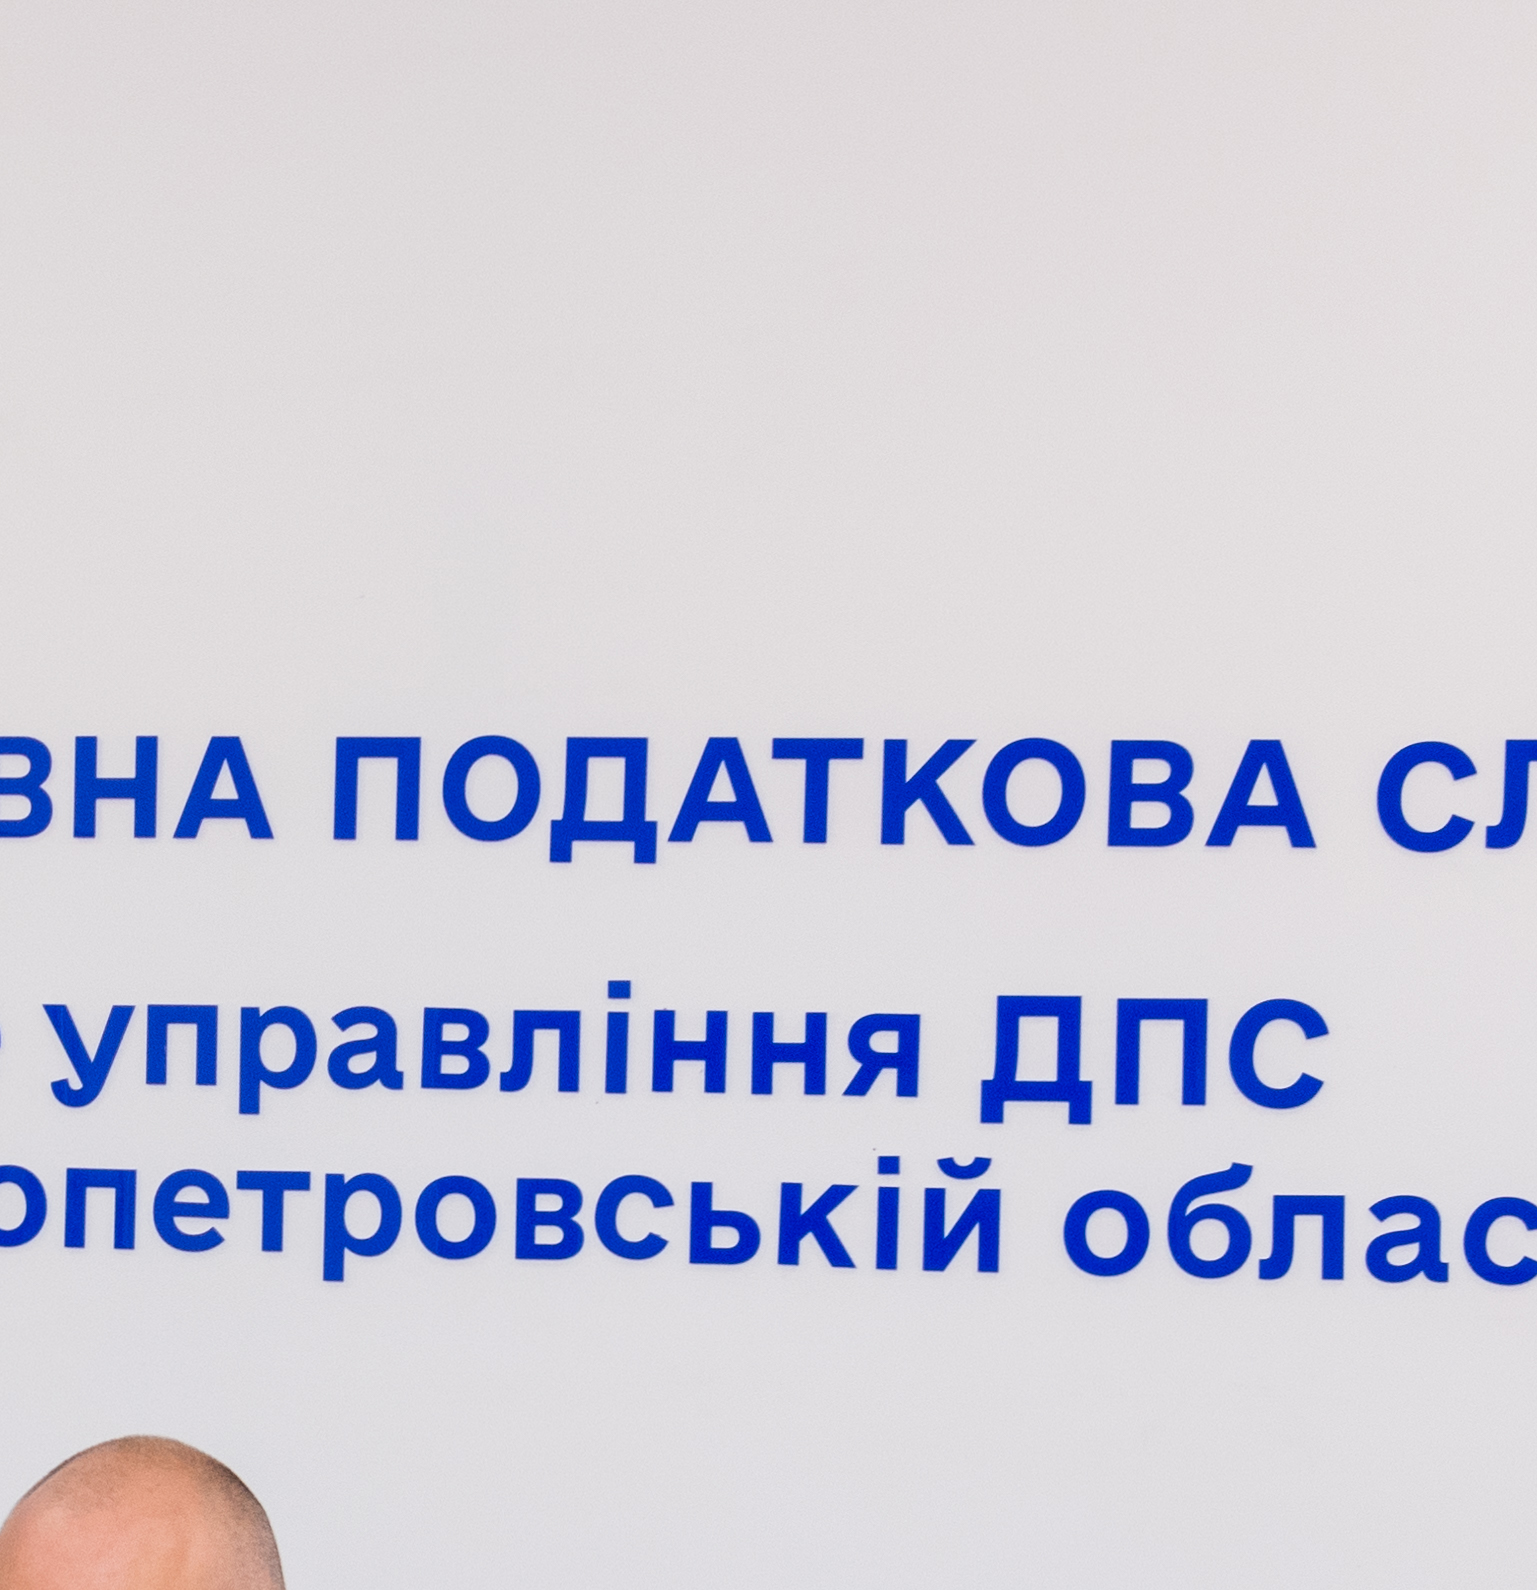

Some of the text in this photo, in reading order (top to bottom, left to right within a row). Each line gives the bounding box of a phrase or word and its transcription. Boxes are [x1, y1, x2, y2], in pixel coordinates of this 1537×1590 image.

[332, 733, 1318, 865] ПОДАТКОВА
[42, 979, 922, 1117] управління
[979, 994, 1330, 1126] ДПС
